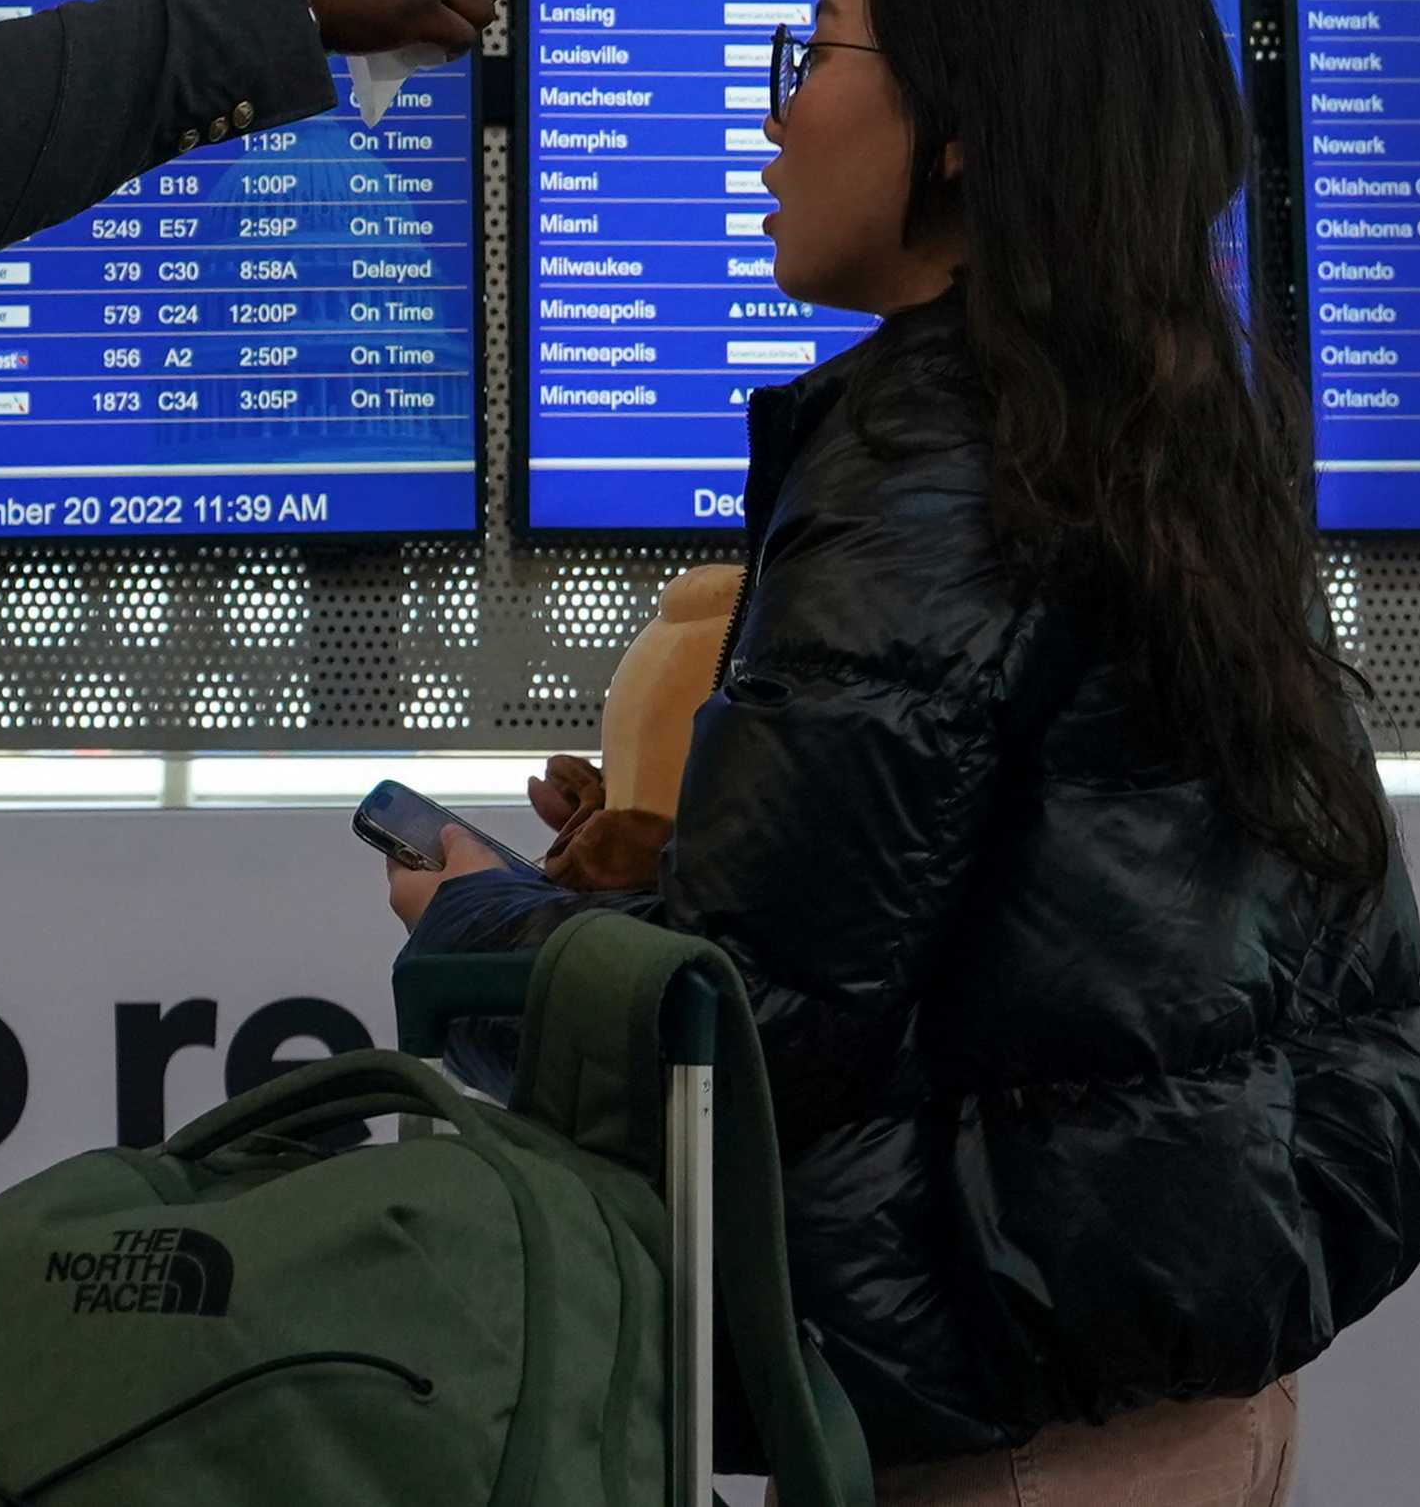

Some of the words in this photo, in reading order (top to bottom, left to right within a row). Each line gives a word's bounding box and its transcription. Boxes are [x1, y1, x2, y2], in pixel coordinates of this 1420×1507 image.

[1316, 219, 1412, 238] Oklahoma
[104, 262, 141, 281] 379
[159, 262, 199, 280] C30
[240, 261, 297, 279] 8:58A
[353, 260, 431, 283] Delayed
[541, 300, 656, 323] Minneapolis
[746, 303, 797, 317] DELTA
[1322, 389, 1399, 408] Orlando
[64, 497, 100, 524] 20
[110, 496, 182, 523] 2022
[194, 495, 271, 522] 11:39
[279, 494, 327, 521] AM
[113, 1228, 178, 1251] THE
[46, 1253, 168, 1282] NORTH
[73, 1284, 162, 1313] FACE
